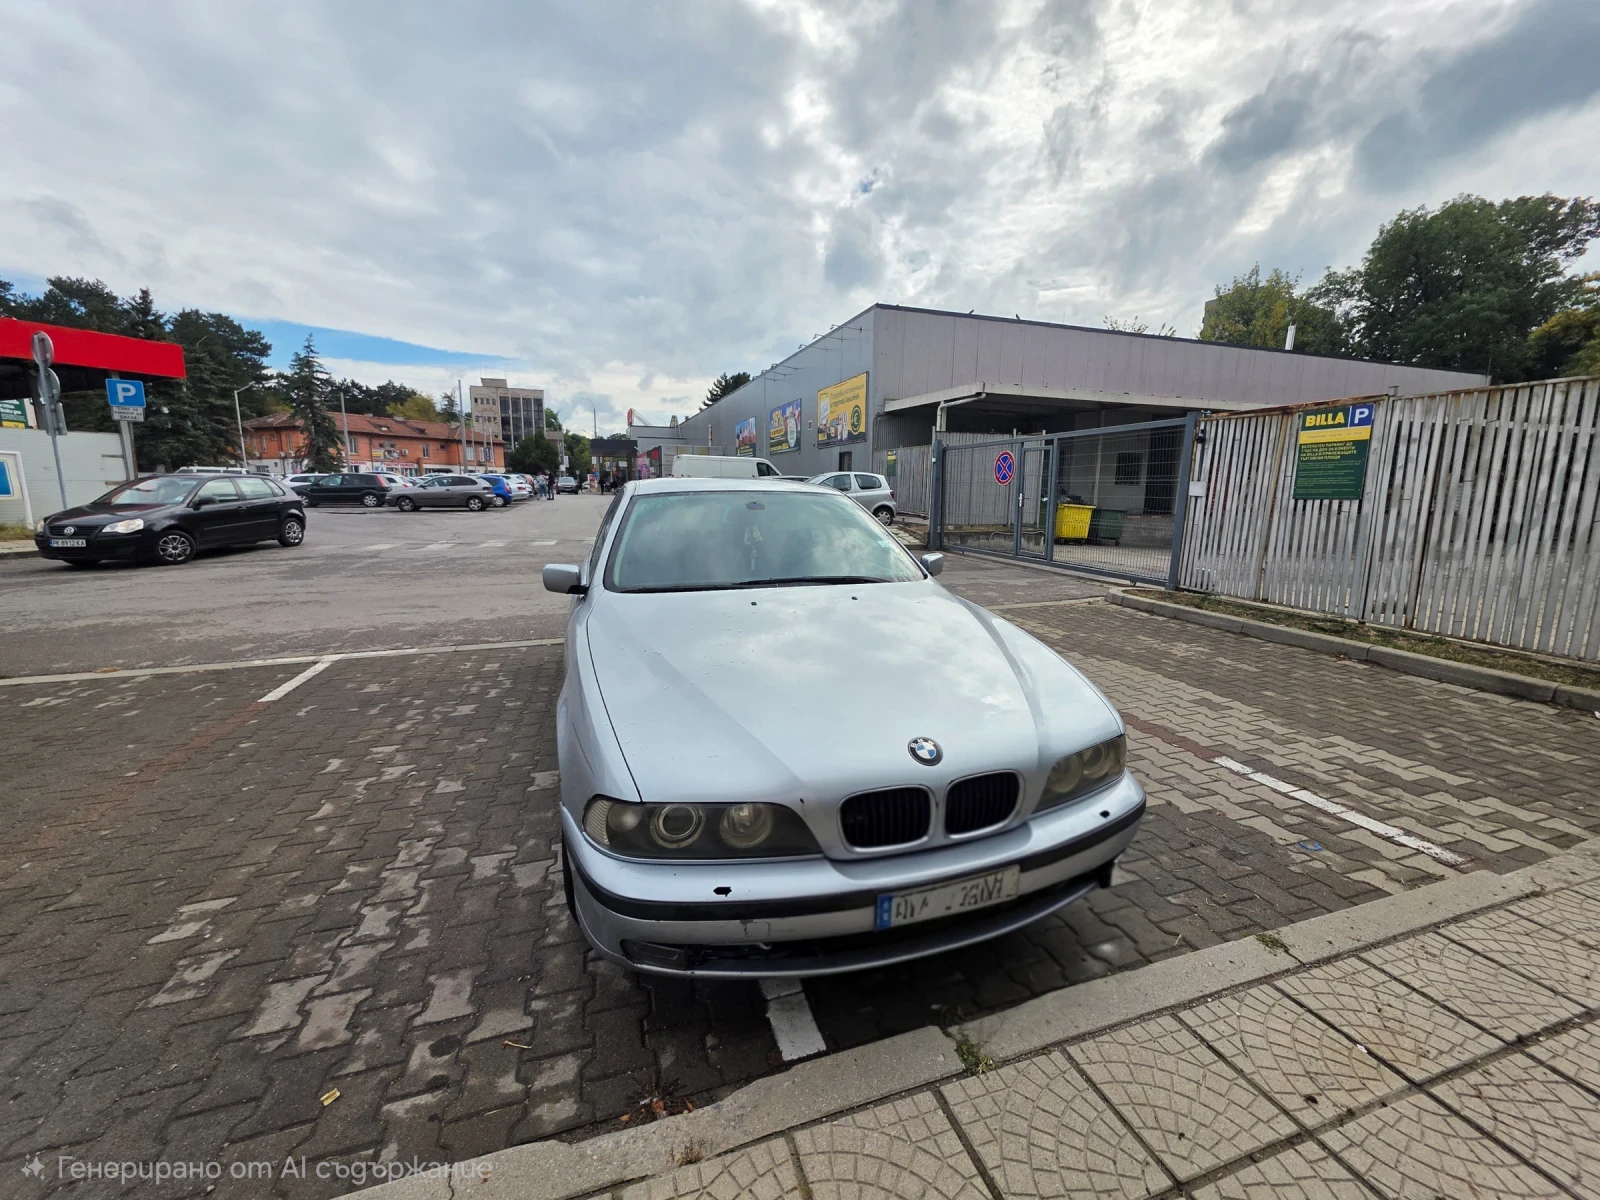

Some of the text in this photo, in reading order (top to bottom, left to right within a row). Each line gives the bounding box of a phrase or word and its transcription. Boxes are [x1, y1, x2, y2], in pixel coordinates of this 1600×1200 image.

[116, 383, 136, 403] P
[1305, 411, 1345, 427] BILLA
[1354, 408, 1369, 424] P
